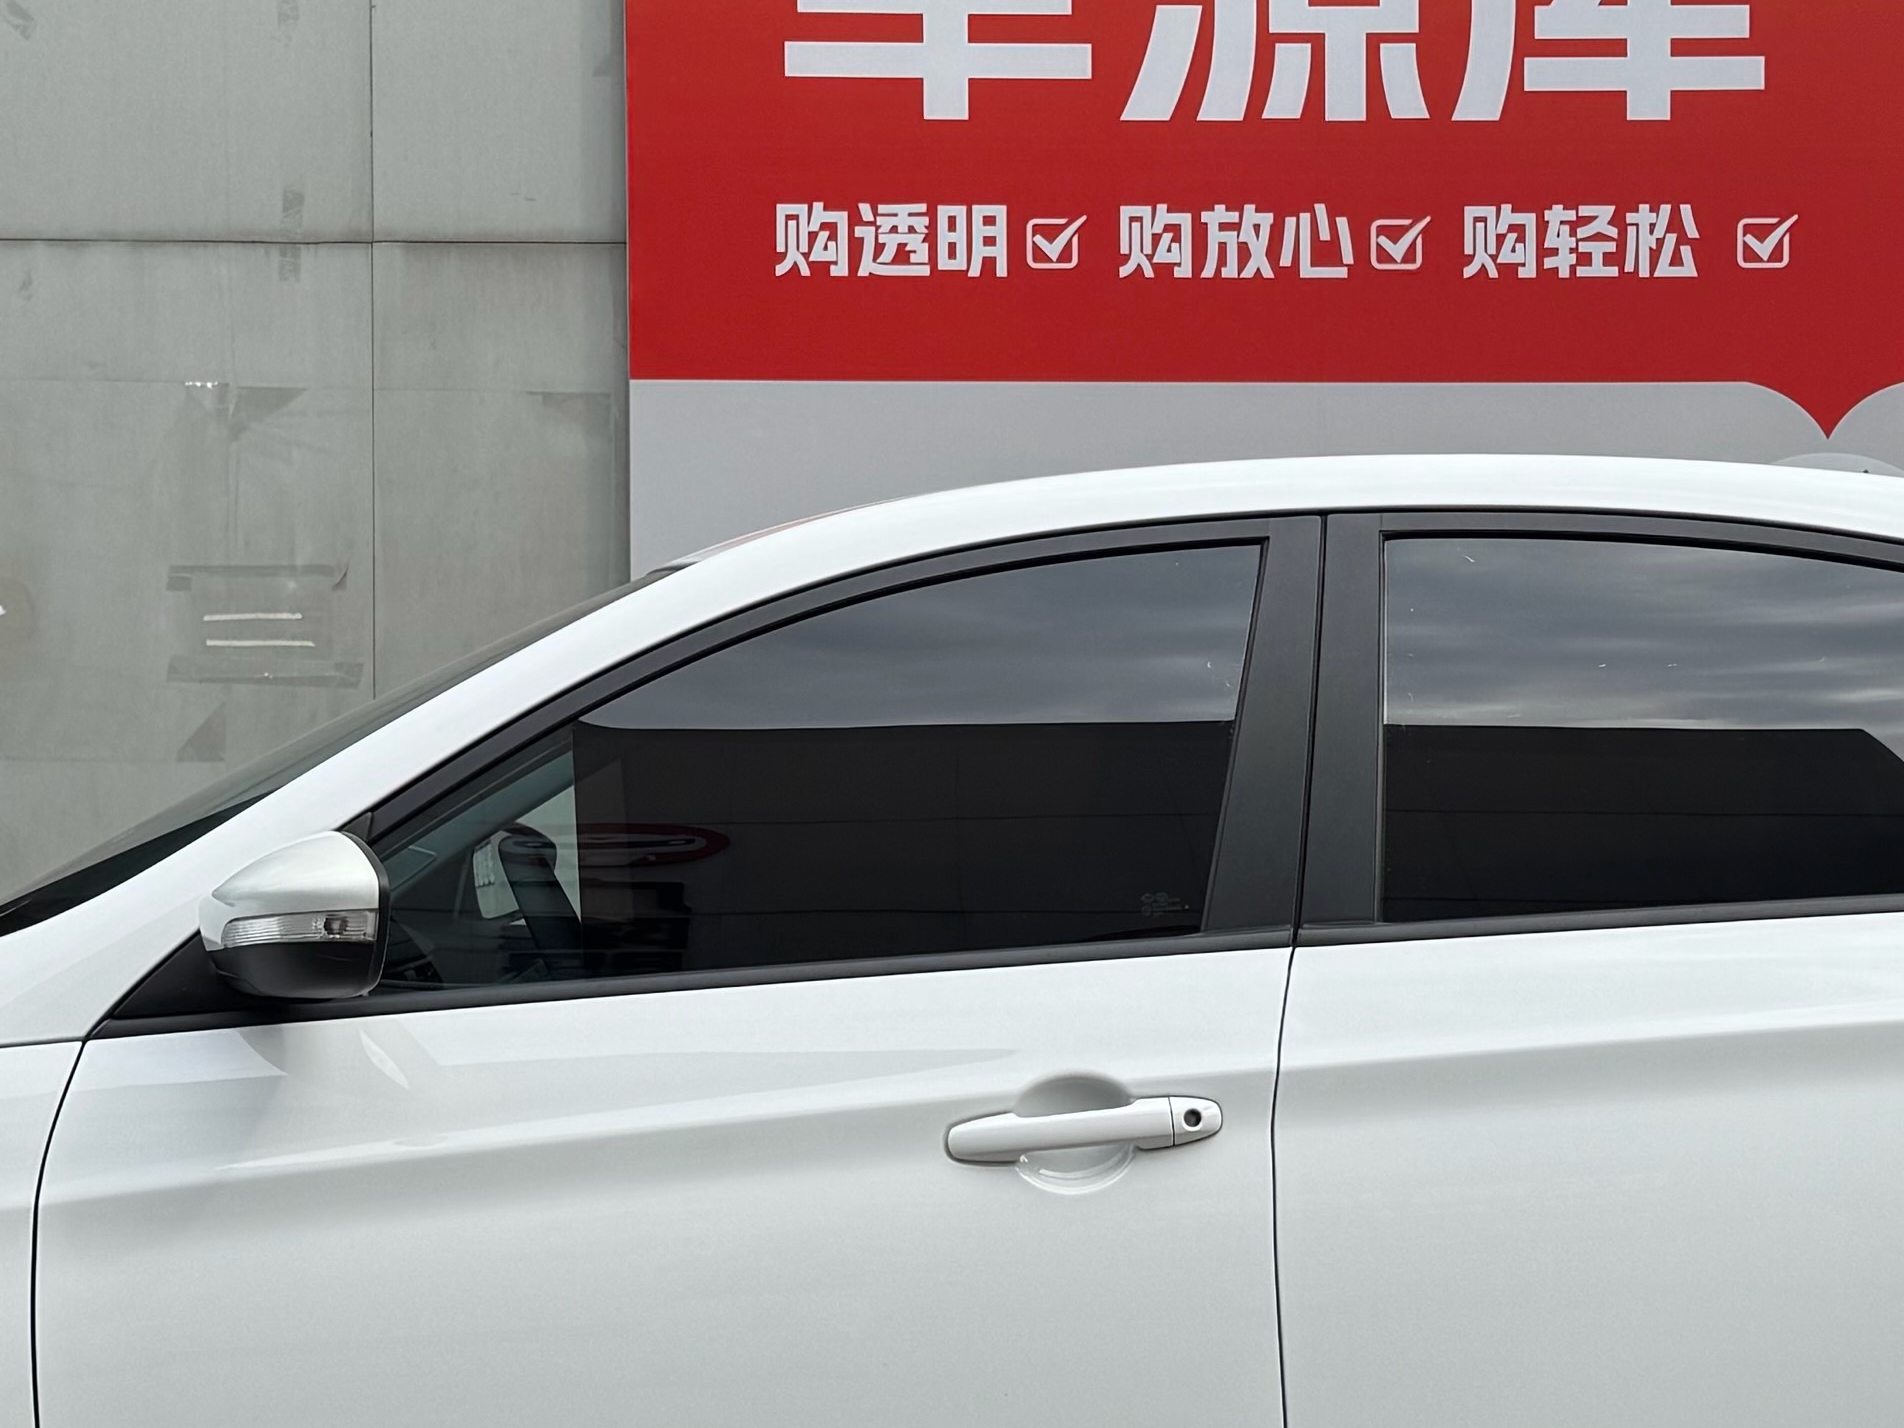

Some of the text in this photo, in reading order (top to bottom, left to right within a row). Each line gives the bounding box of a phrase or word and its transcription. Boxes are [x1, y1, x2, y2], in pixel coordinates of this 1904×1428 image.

[774, 201, 1700, 280] 购透明 购放心 购轻松
